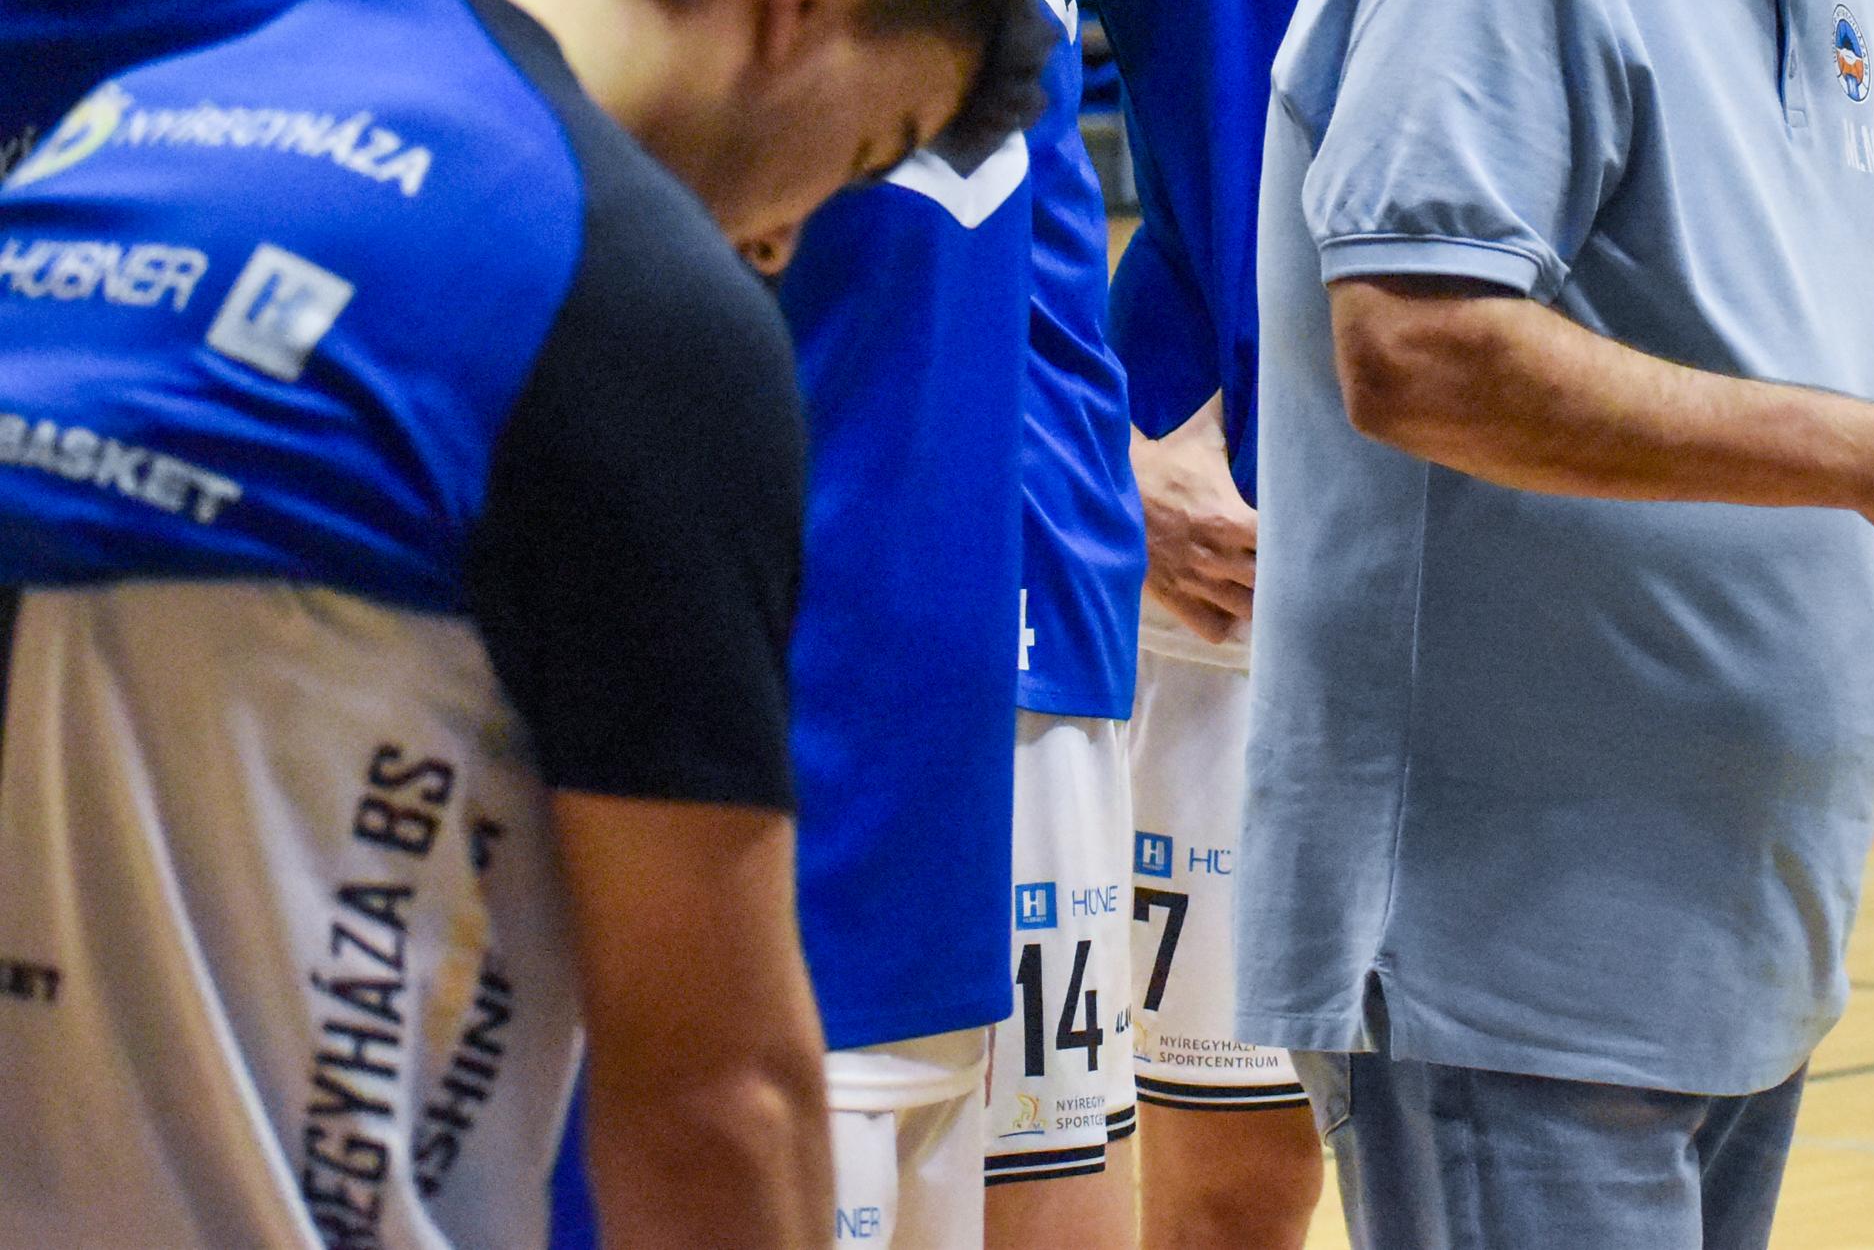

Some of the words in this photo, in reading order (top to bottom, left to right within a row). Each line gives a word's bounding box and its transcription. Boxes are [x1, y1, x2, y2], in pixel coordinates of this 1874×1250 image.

[1016, 940, 1103, 1076] 14
[1133, 886, 1189, 1012] 7
[1159, 1052, 1279, 1069] SPORTCENTRUM
